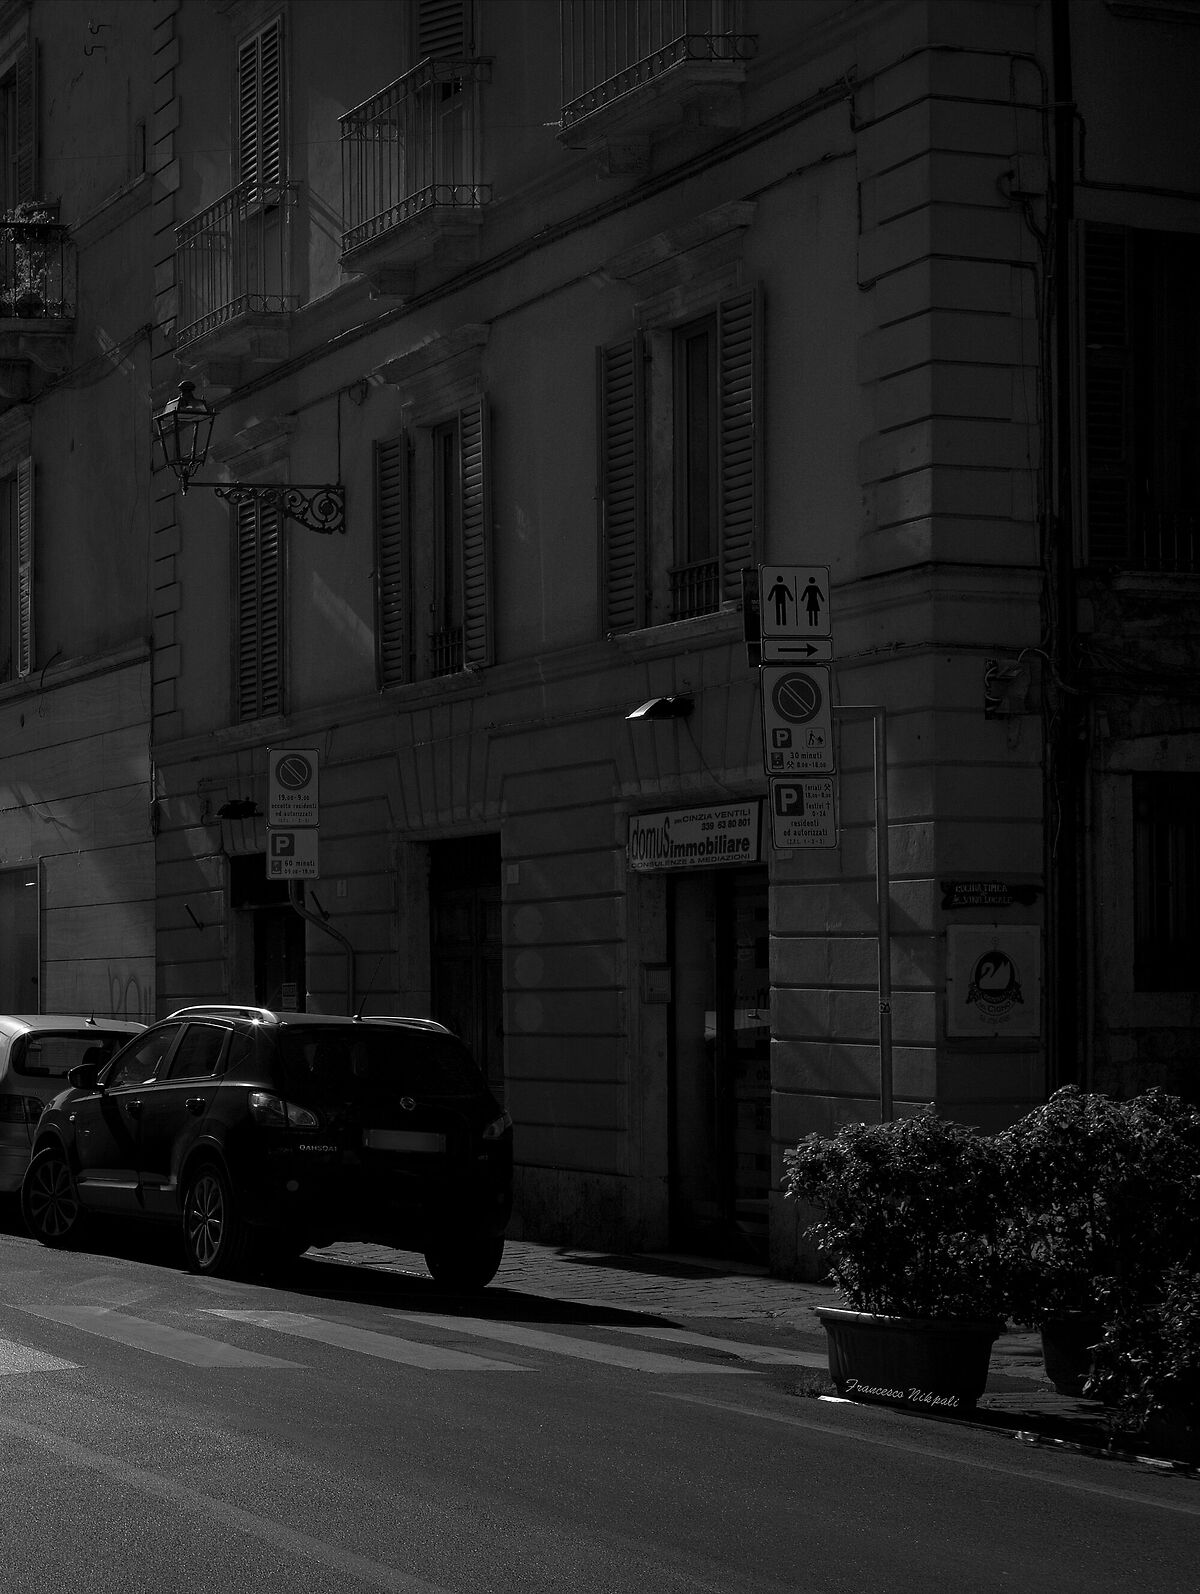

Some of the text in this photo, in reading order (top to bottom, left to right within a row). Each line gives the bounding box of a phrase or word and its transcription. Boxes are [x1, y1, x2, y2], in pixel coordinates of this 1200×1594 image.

[776, 729, 789, 747] P
[800, 751, 822, 759] minuti
[781, 788, 798, 813] P
[682, 813, 713, 823] CINZIA
[714, 808, 751, 819] VENTILI
[791, 819, 819, 827] residenti
[783, 828, 828, 836] ed autorizzati
[276, 836, 290, 854] P
[669, 834, 750, 858] immobiliare
[631, 858, 687, 869] CONSULENZE
[697, 853, 750, 864] MEDIAZIONI
